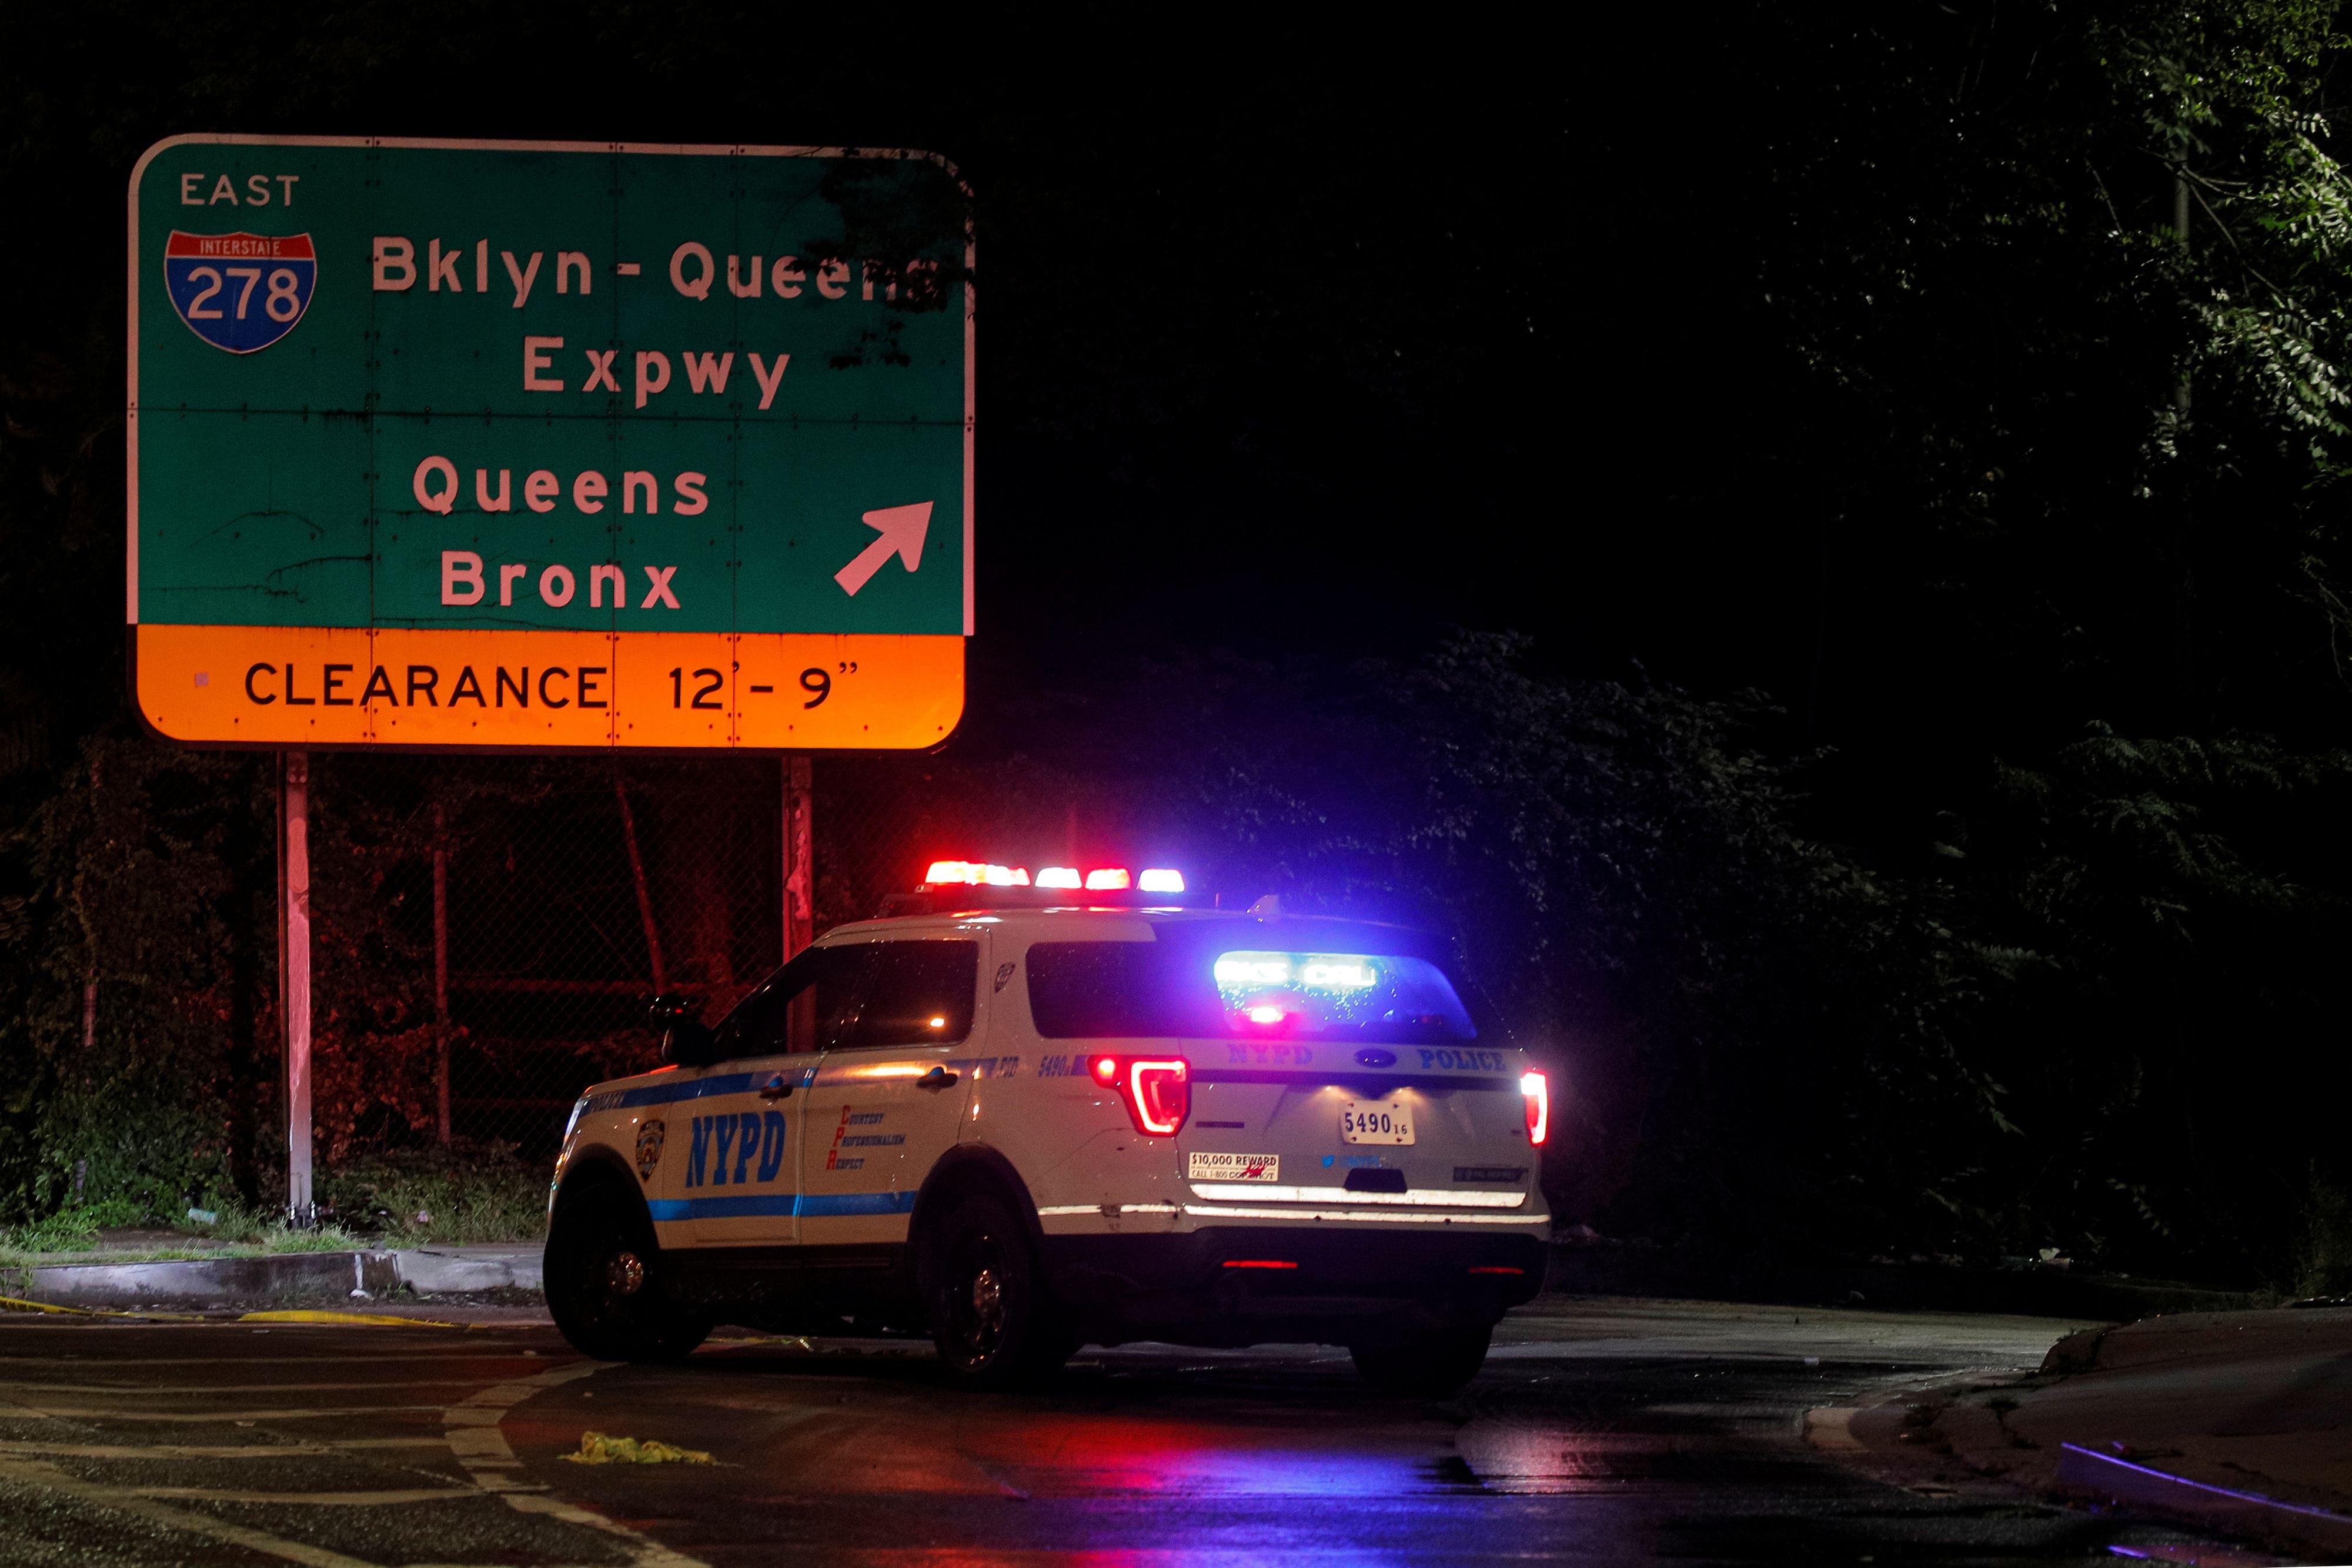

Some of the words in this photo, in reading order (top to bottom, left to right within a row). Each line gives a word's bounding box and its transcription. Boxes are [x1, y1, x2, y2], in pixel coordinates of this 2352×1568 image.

[181, 174, 300, 207] EAST
[199, 239, 282, 256] INTERSTATE
[186, 267, 300, 322] 278
[373, 236, 592, 309] Bklyn
[523, 336, 791, 410] Expwy
[413, 455, 709, 516] Queens
[441, 550, 681, 609] Bronx
[245, 663, 608, 708] CLEARANCE
[1228, 1044, 1312, 1064] NYPD
[1419, 1049, 1507, 1071] POLICE
[1345, 1112, 1391, 1133] 5490
[1394, 1124, 1407, 1135] 16
[686, 1111, 786, 1187] NYPD
[1192, 1154, 1232, 1166] $10,000
[1236, 1156, 1277, 1166] REWARD
[1191, 1170, 1207, 1178] CALL
